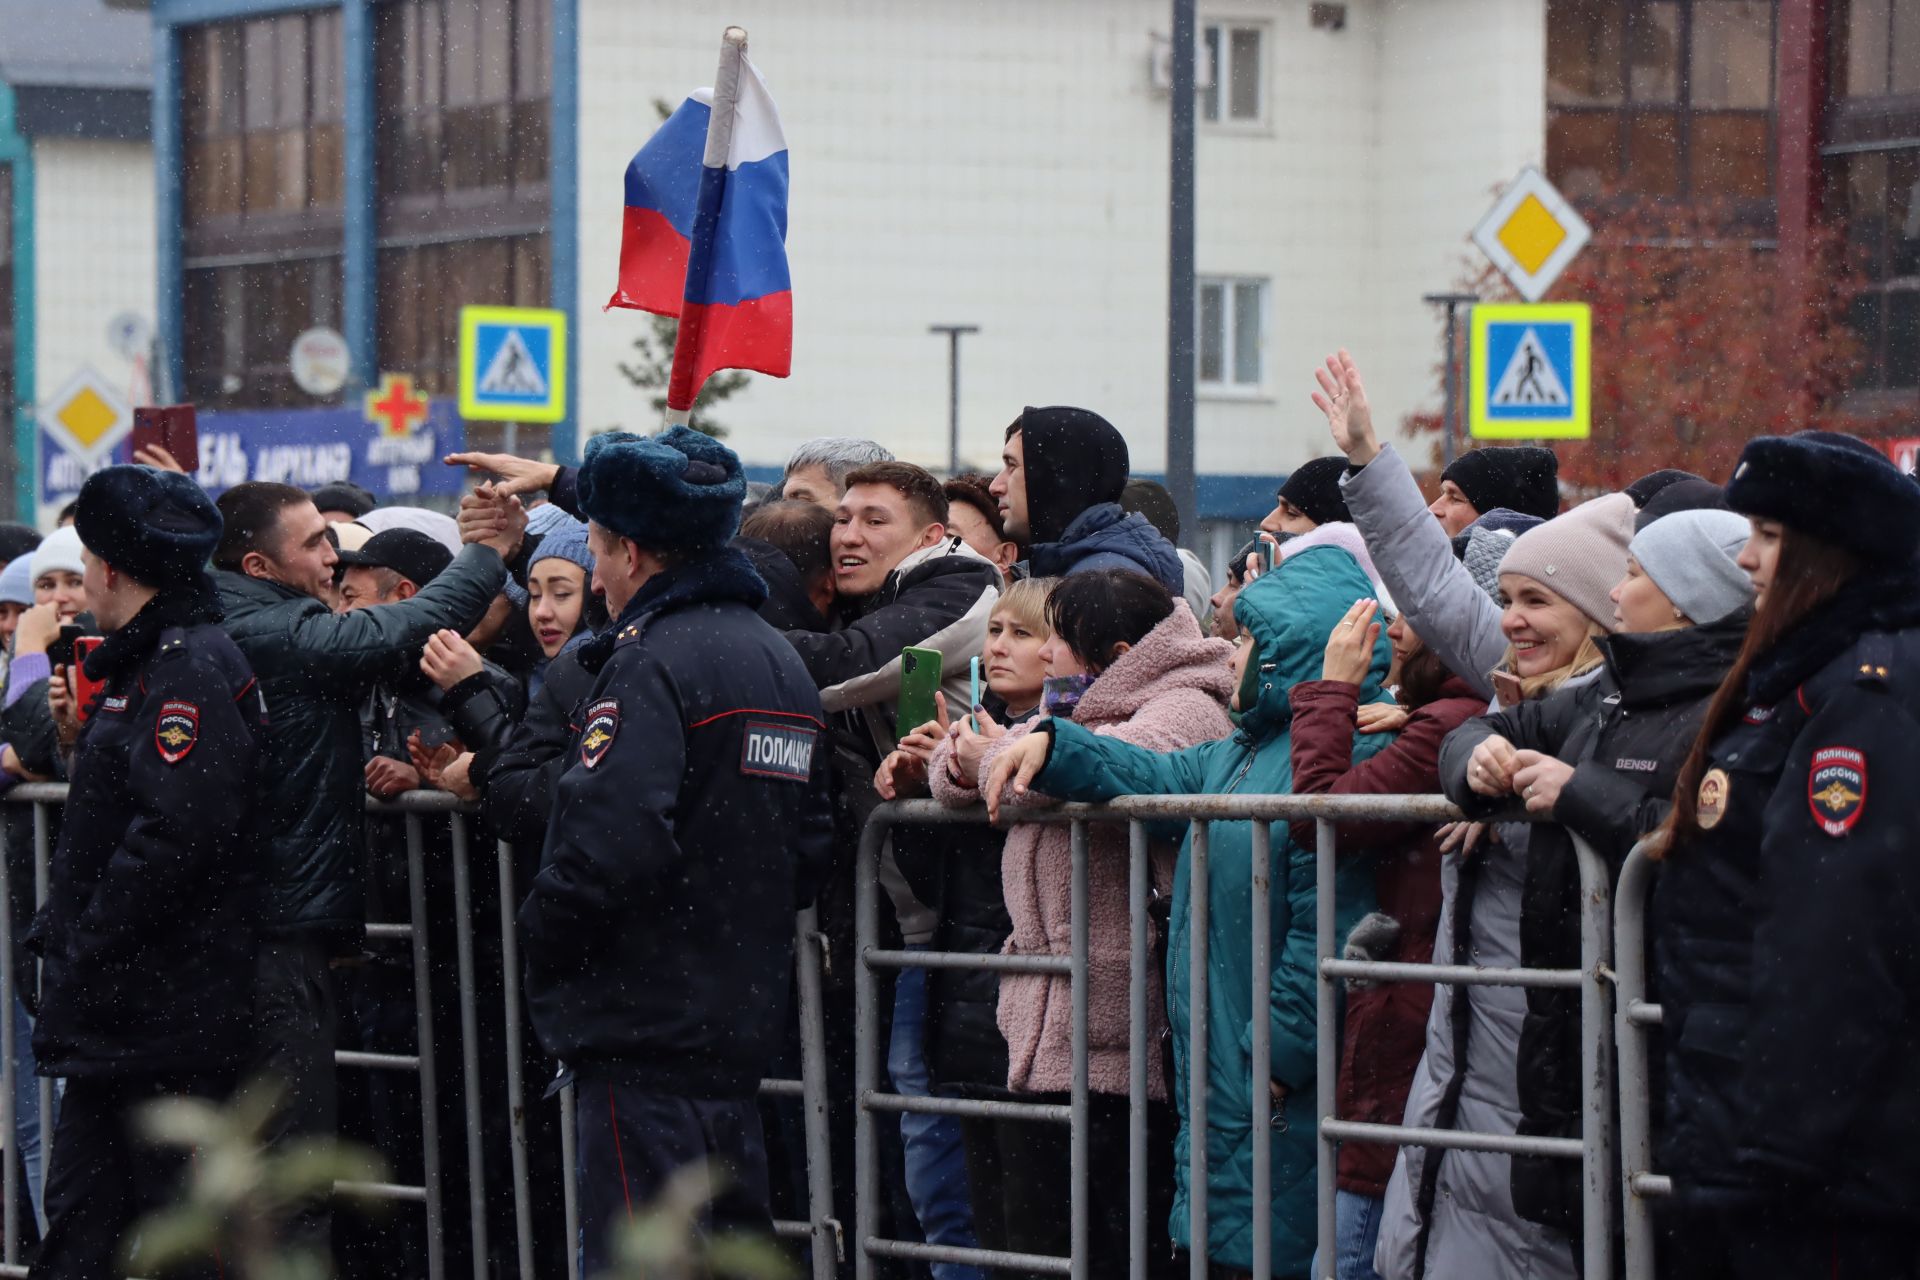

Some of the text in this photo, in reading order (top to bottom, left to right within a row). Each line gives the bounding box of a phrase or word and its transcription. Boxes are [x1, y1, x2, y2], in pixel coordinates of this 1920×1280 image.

[197, 432, 248, 488] ЕЛЬ
[163, 703, 196, 715] ПОЛИЦИЯ
[588, 702, 617, 716] ПОЛИЦИЯ
[161, 715, 193, 728] РОССИЯ
[747, 733, 812, 774] ПОЛИЦИЯ
[1816, 749, 1861, 765] ПОЛИЦИЯ
[1615, 758, 1657, 771] BENSU
[1815, 766, 1859, 784] РОССИЯ
